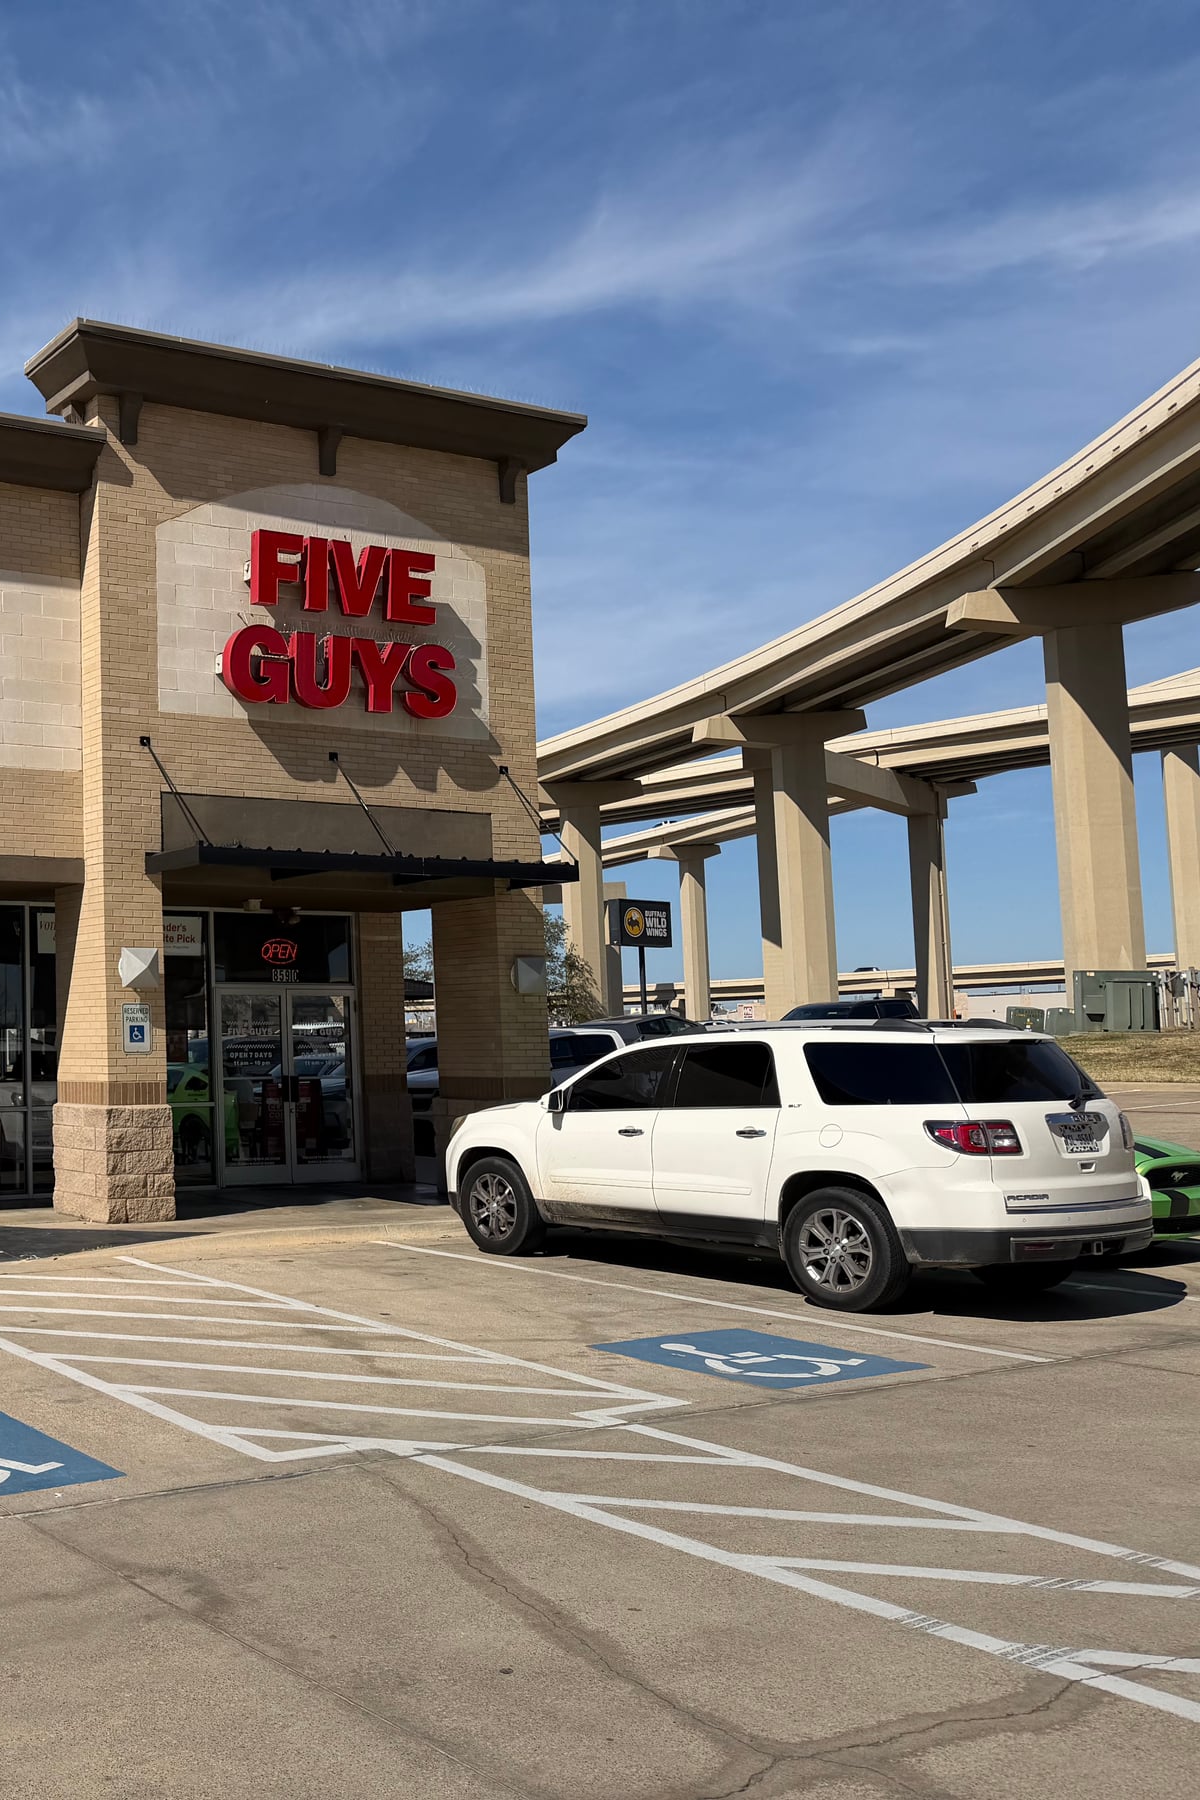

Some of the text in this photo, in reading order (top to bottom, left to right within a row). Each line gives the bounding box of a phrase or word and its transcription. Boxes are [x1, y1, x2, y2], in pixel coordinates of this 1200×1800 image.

[250, 529, 437, 625] FIVE
[222, 624, 458, 719] GUYS
[645, 917, 667, 928] WILD
[646, 928, 668, 937] WINGS
[177, 934, 195, 943] Pick
[261, 944, 297, 959] OPEN
[250, 1028, 273, 1036] GUYS
[319, 1028, 343, 1036] GUYS
